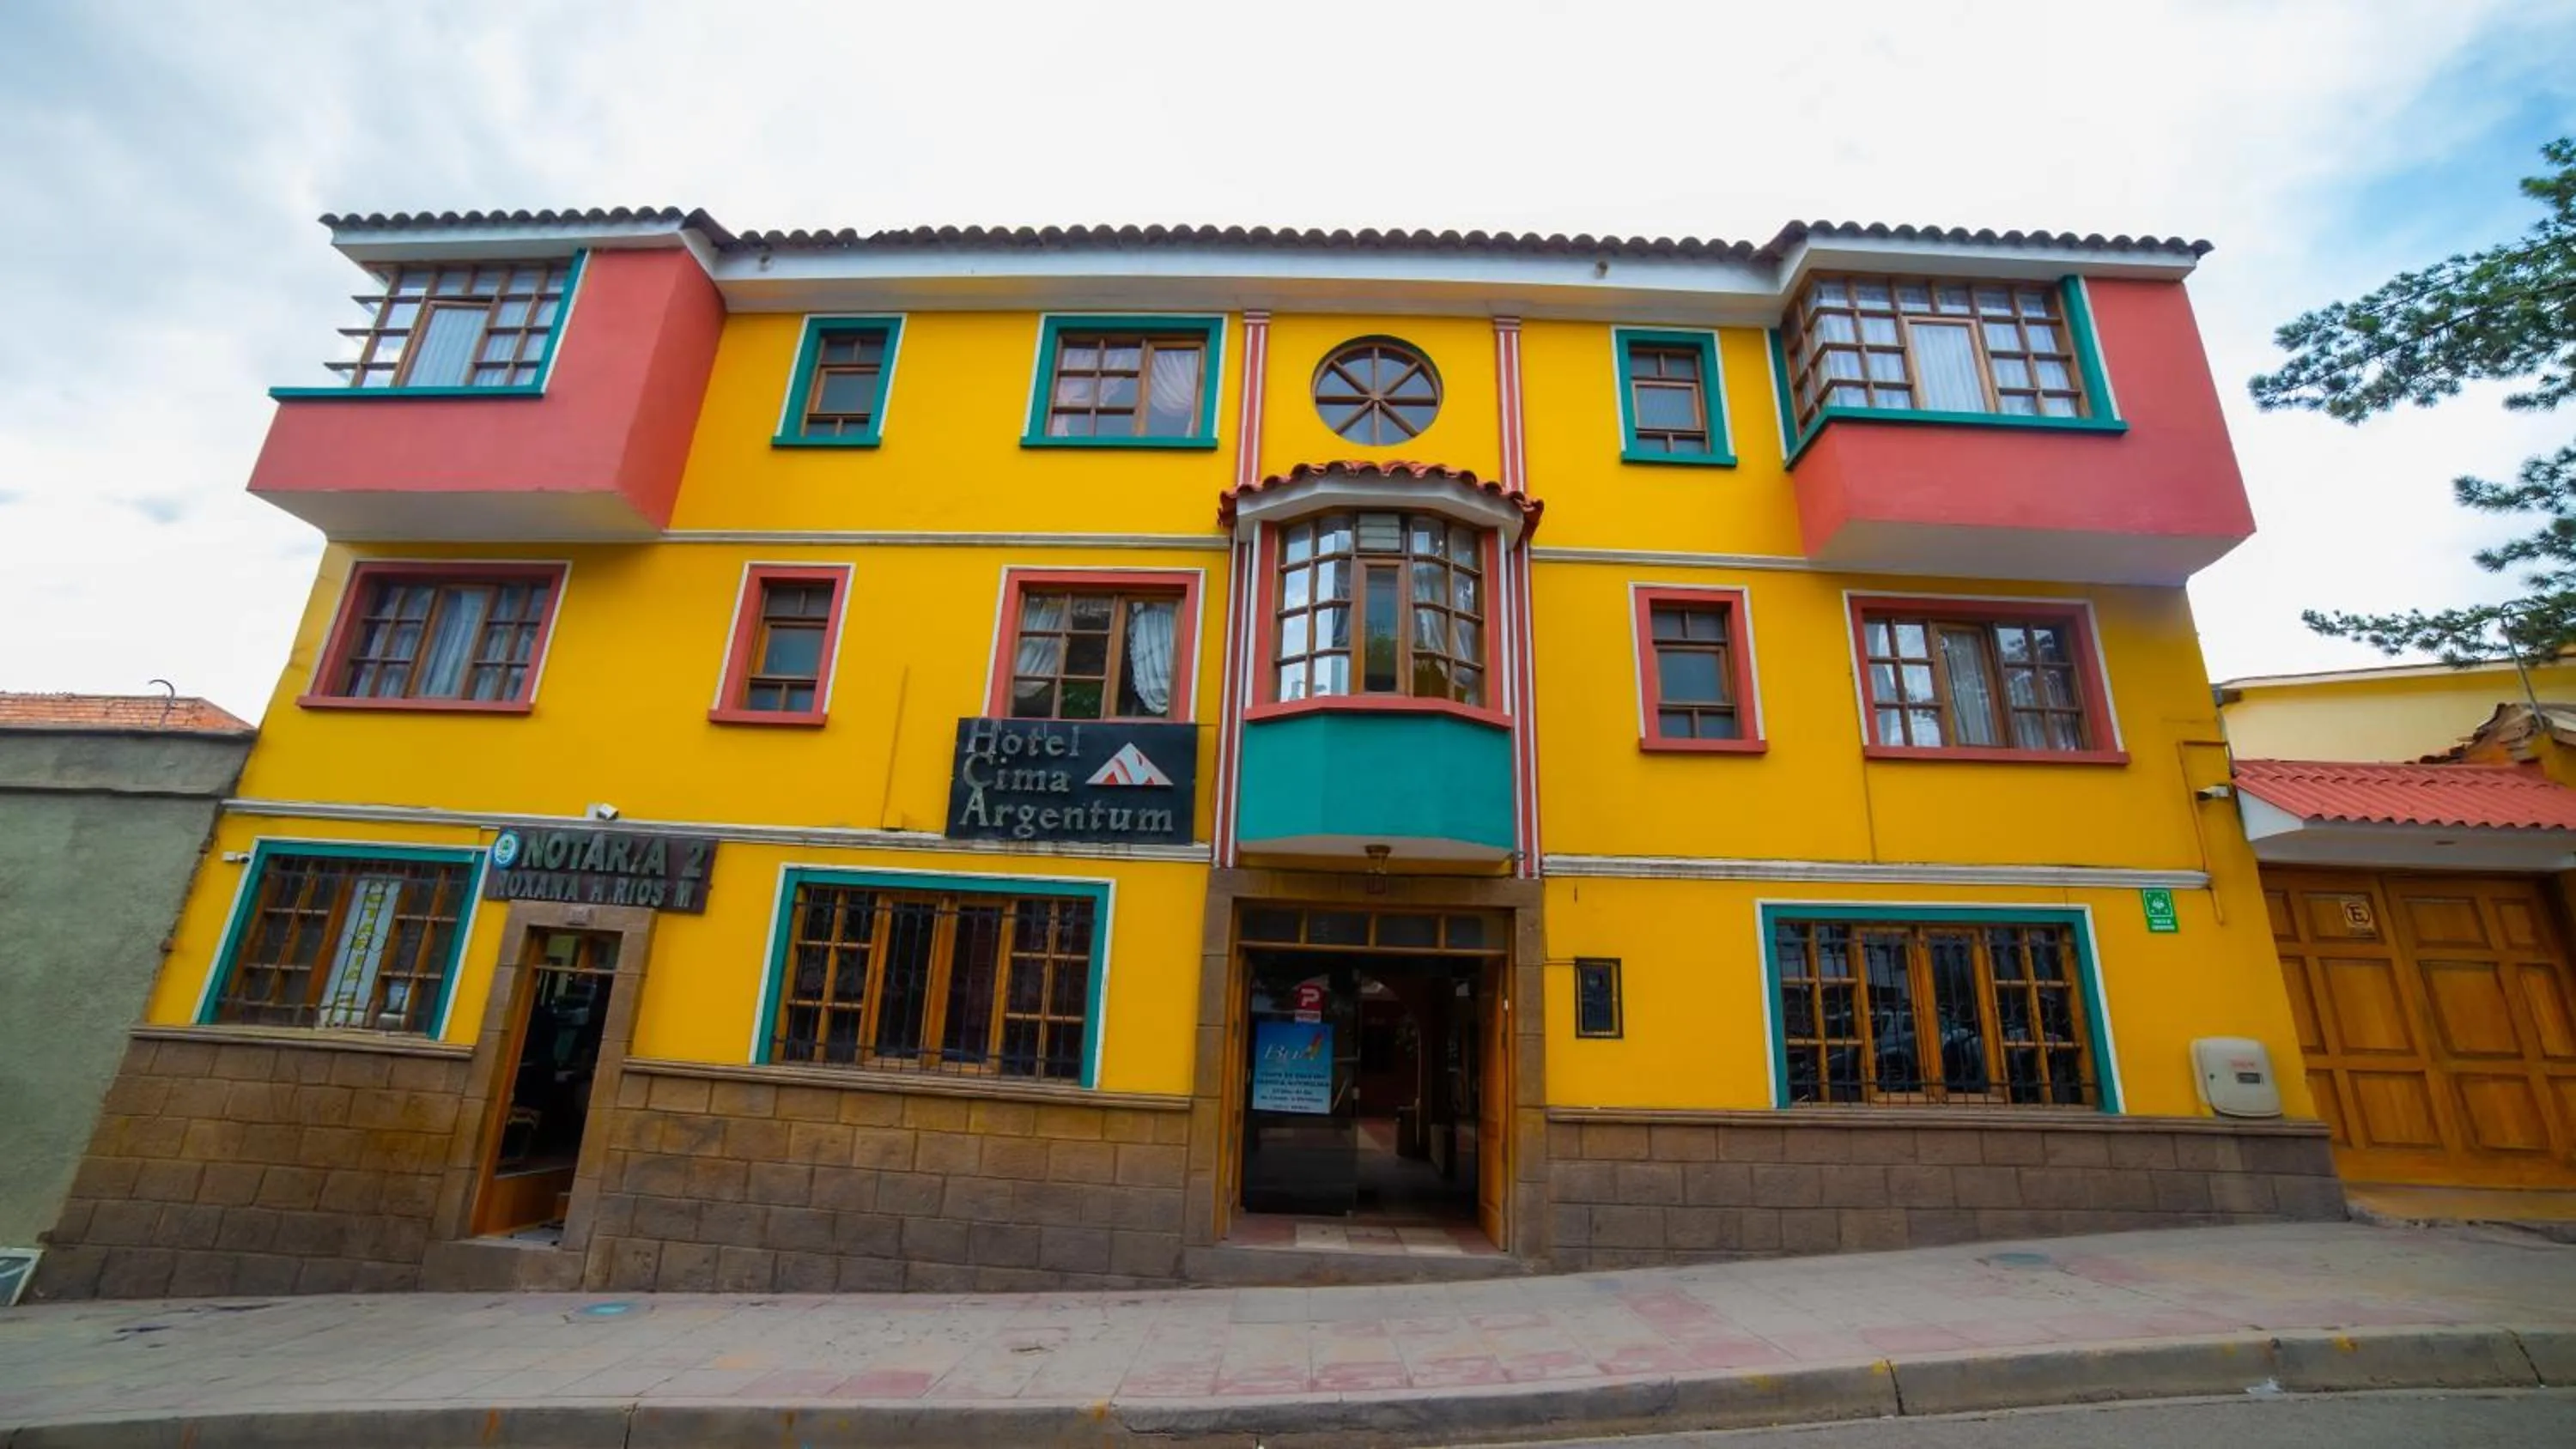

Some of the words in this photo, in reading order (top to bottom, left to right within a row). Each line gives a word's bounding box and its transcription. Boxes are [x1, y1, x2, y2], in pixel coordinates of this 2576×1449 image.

[965, 718, 1079, 756] Hotel
[963, 751, 1071, 792] Cima
[959, 785, 1173, 839] Argentum
[681, 840, 705, 878] 2
